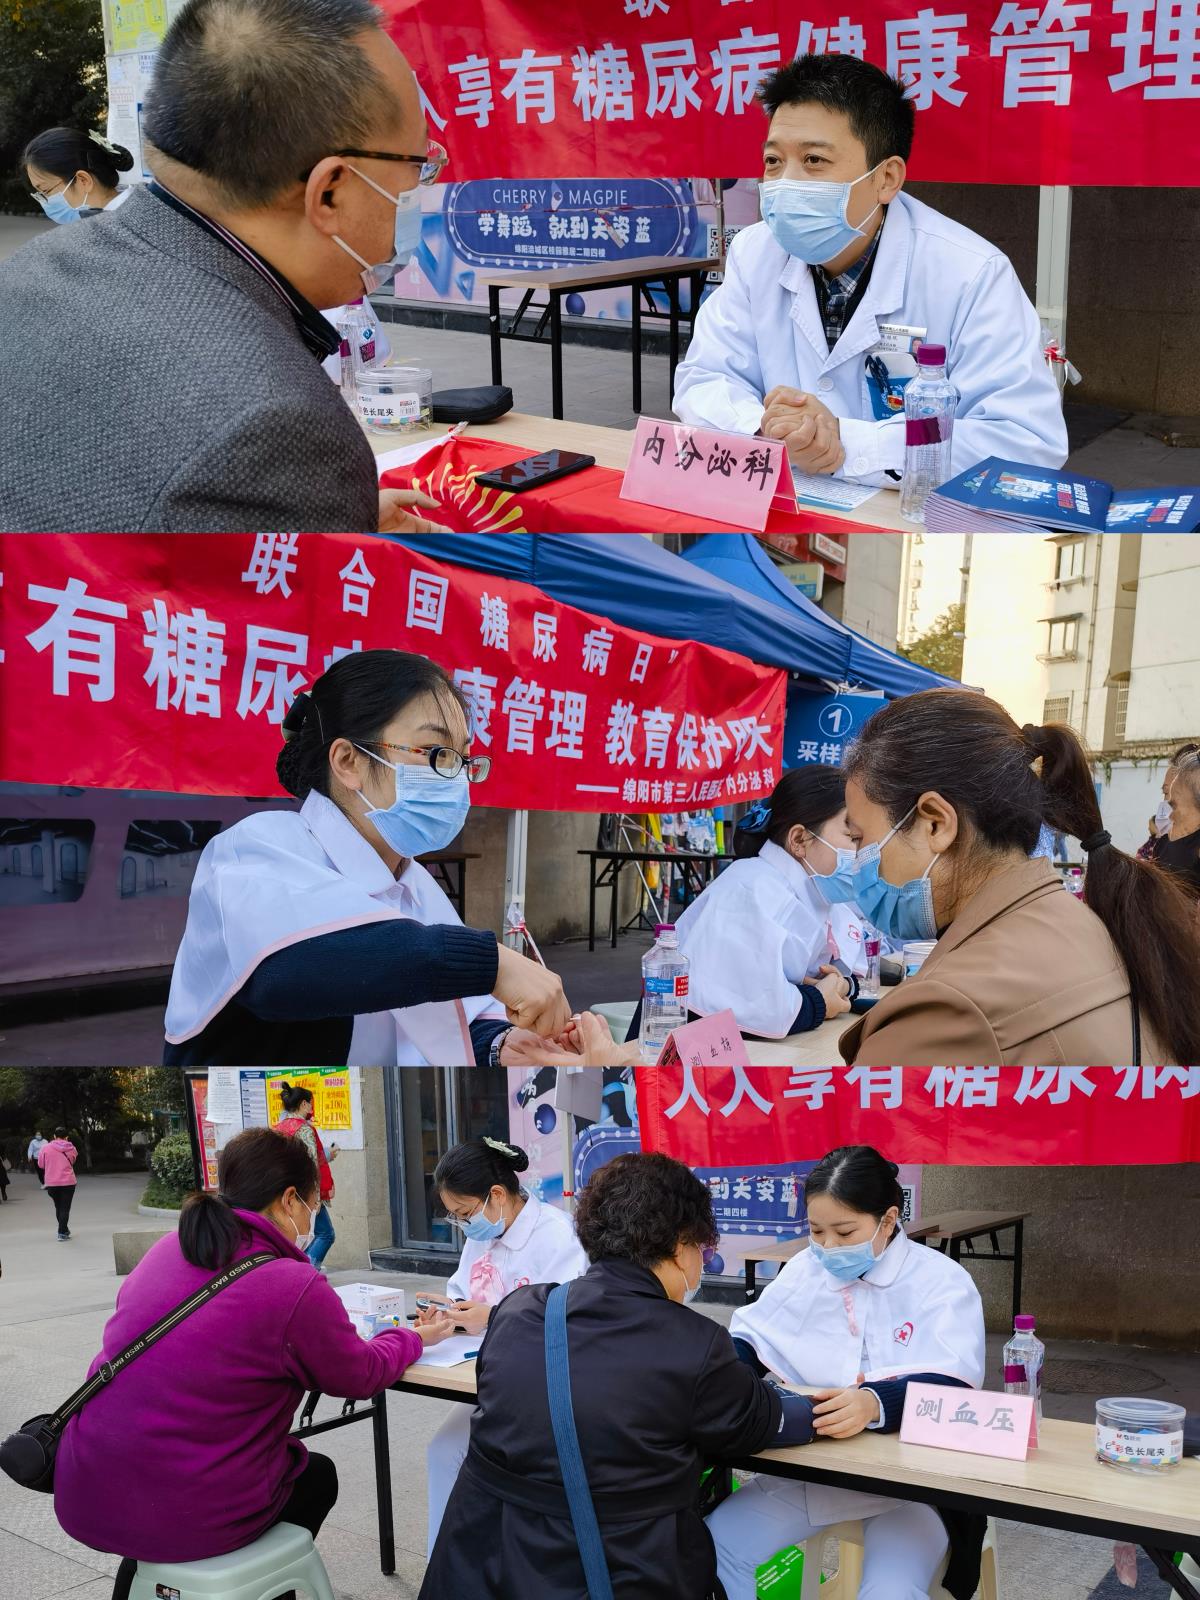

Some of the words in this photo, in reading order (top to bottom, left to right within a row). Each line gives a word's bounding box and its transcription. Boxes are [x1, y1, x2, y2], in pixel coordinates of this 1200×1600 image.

[493, 189, 547, 205] CHERRY
[569, 190, 628, 206] MAGPIE
[643, 426, 774, 490] 内分泌科
[798, 740, 848, 765] 采样
[701, 1176, 796, 1203] 到天姿蓝
[211, 1274, 229, 1290] BAG
[915, 1397, 1015, 1433] 测血压
